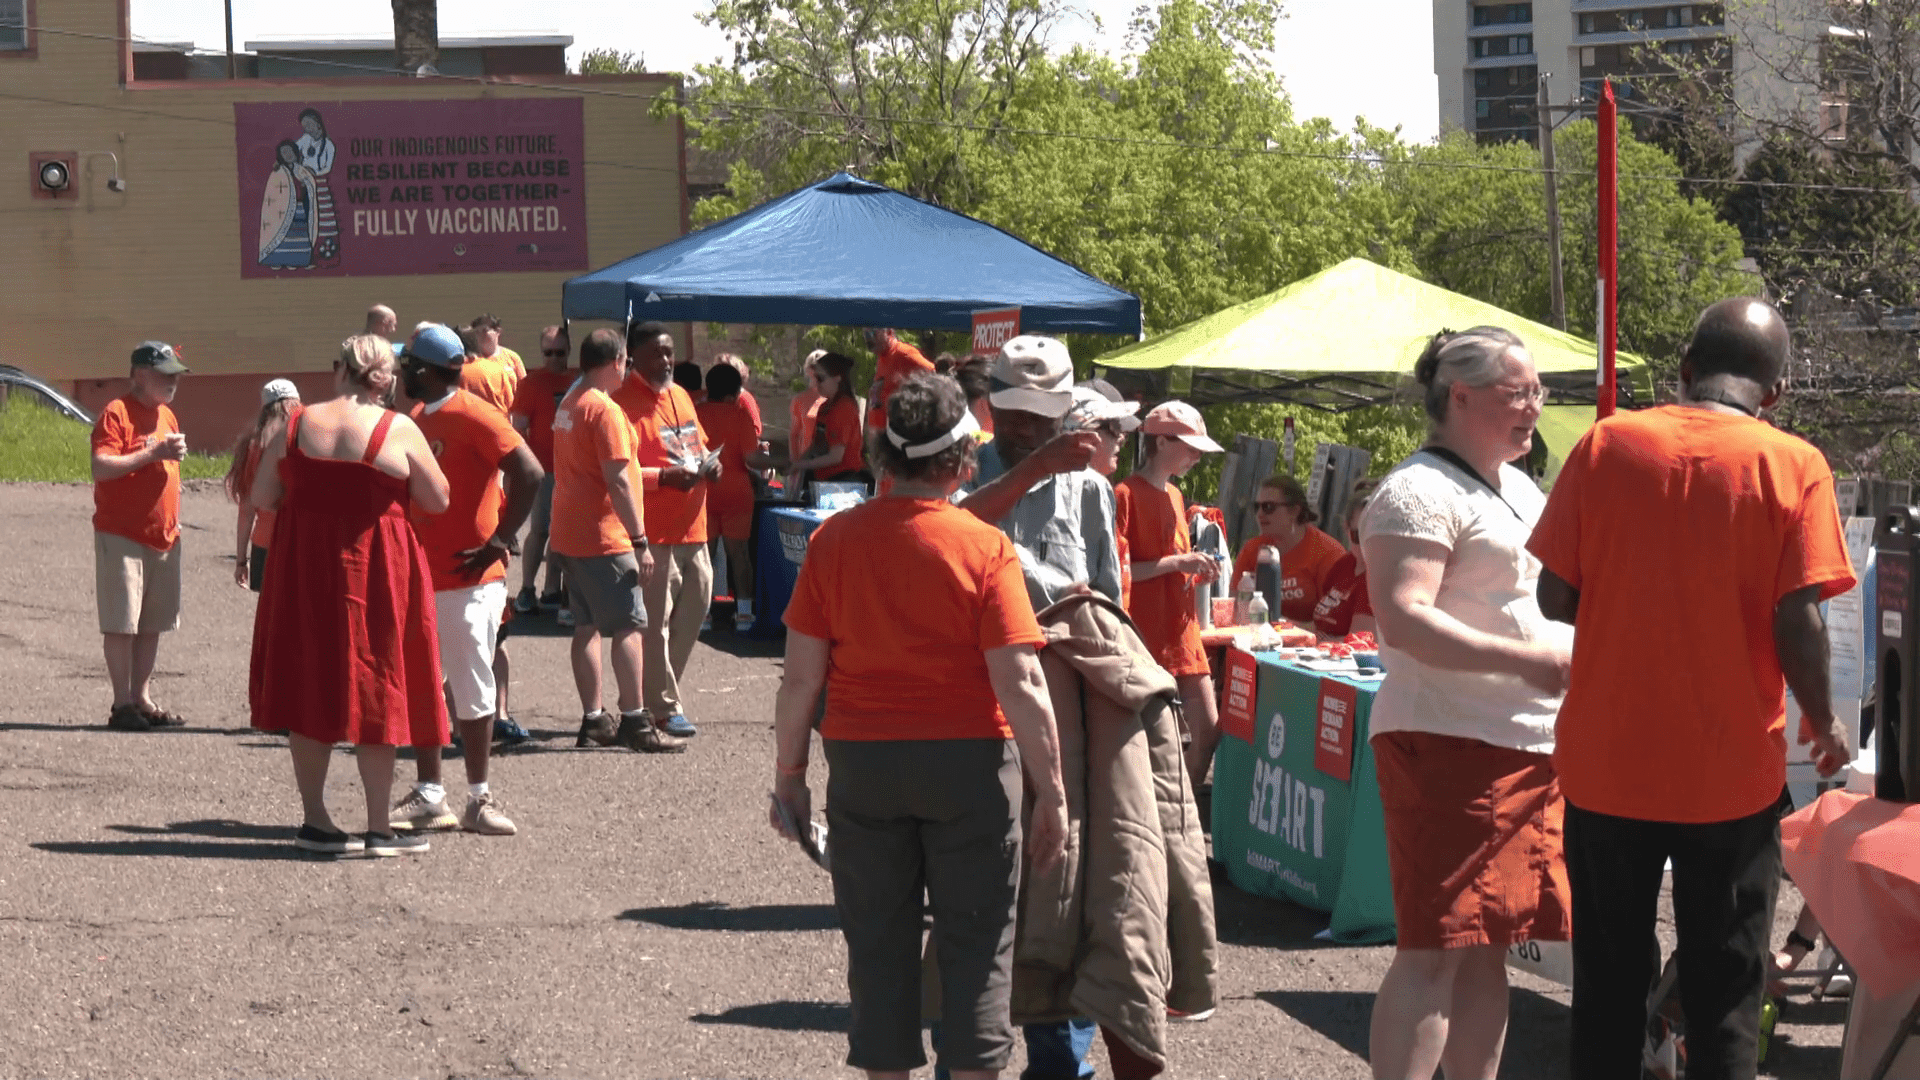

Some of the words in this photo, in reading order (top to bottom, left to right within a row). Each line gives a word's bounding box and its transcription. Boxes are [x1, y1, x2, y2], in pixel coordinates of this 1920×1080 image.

[350, 137, 383, 157] OUR
[390, 135, 490, 157] INDIGENOUS
[346, 162, 460, 181] RESILIENT
[467, 159, 570, 179] BECAUSE
[346, 186, 382, 204] WE
[389, 185, 434, 203] ARE
[353, 208, 418, 236] FULLY
[426, 206, 567, 235] VACCINATED.
[973, 320, 1015, 349] PROTECT
